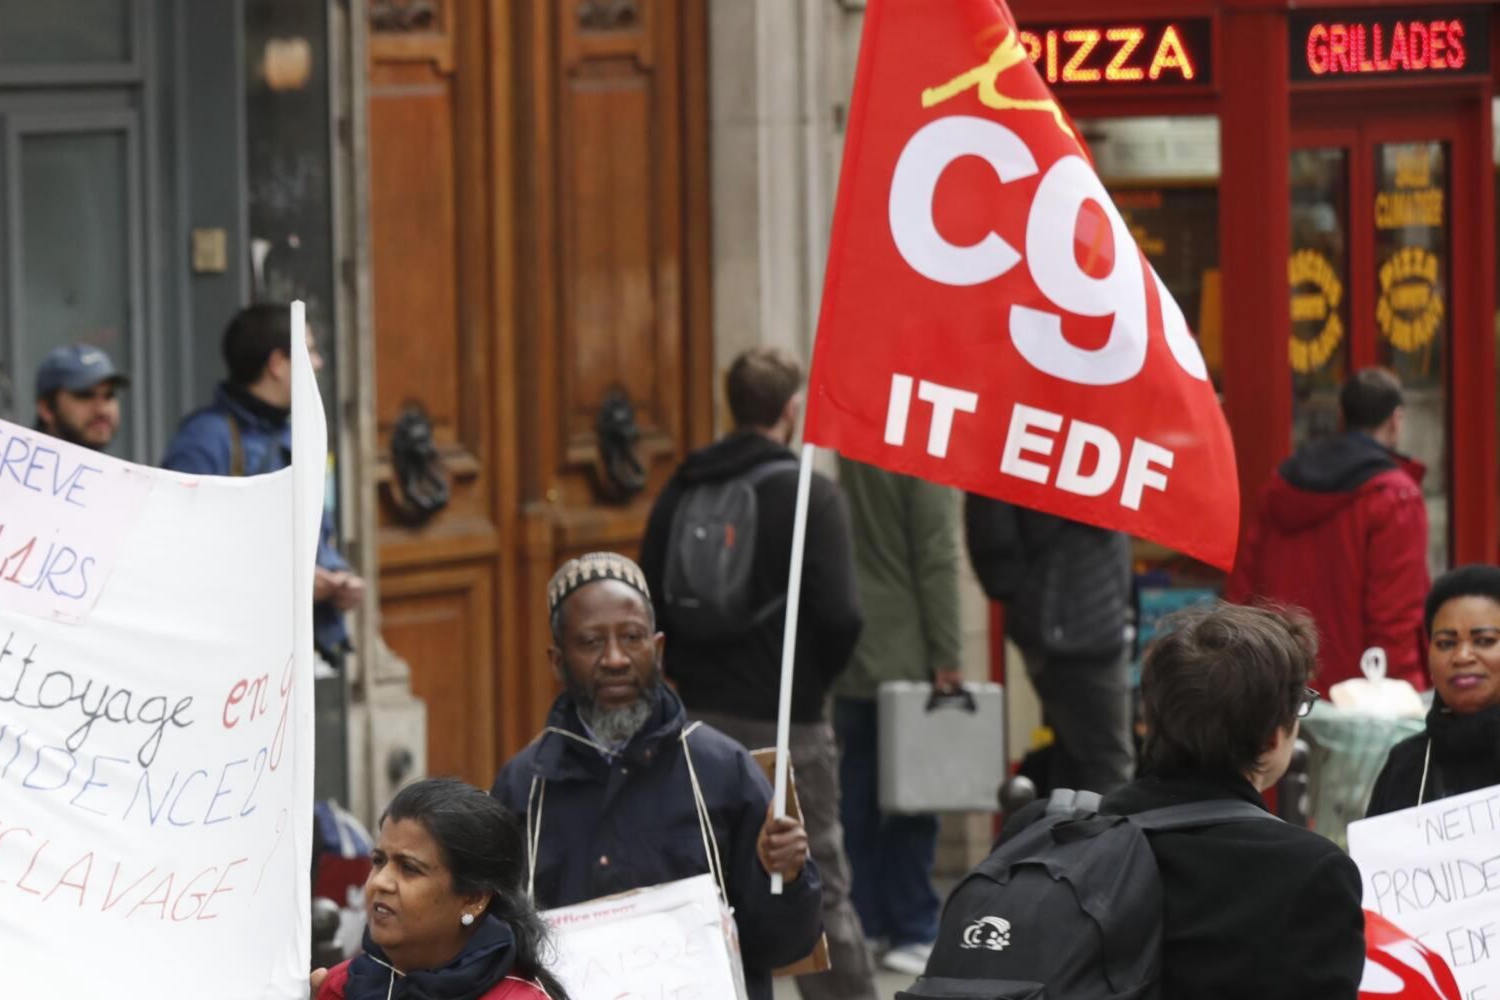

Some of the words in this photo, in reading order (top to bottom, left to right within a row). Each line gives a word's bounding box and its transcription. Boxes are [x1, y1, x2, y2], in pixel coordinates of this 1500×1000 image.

[1306, 20, 1466, 75] GRILLADES
[884, 373, 978, 459] IT
[999, 403, 1175, 511] EDF
[222, 673, 269, 729] en
[1426, 795, 1500, 846] NETT
[1446, 922, 1496, 967] EDF
